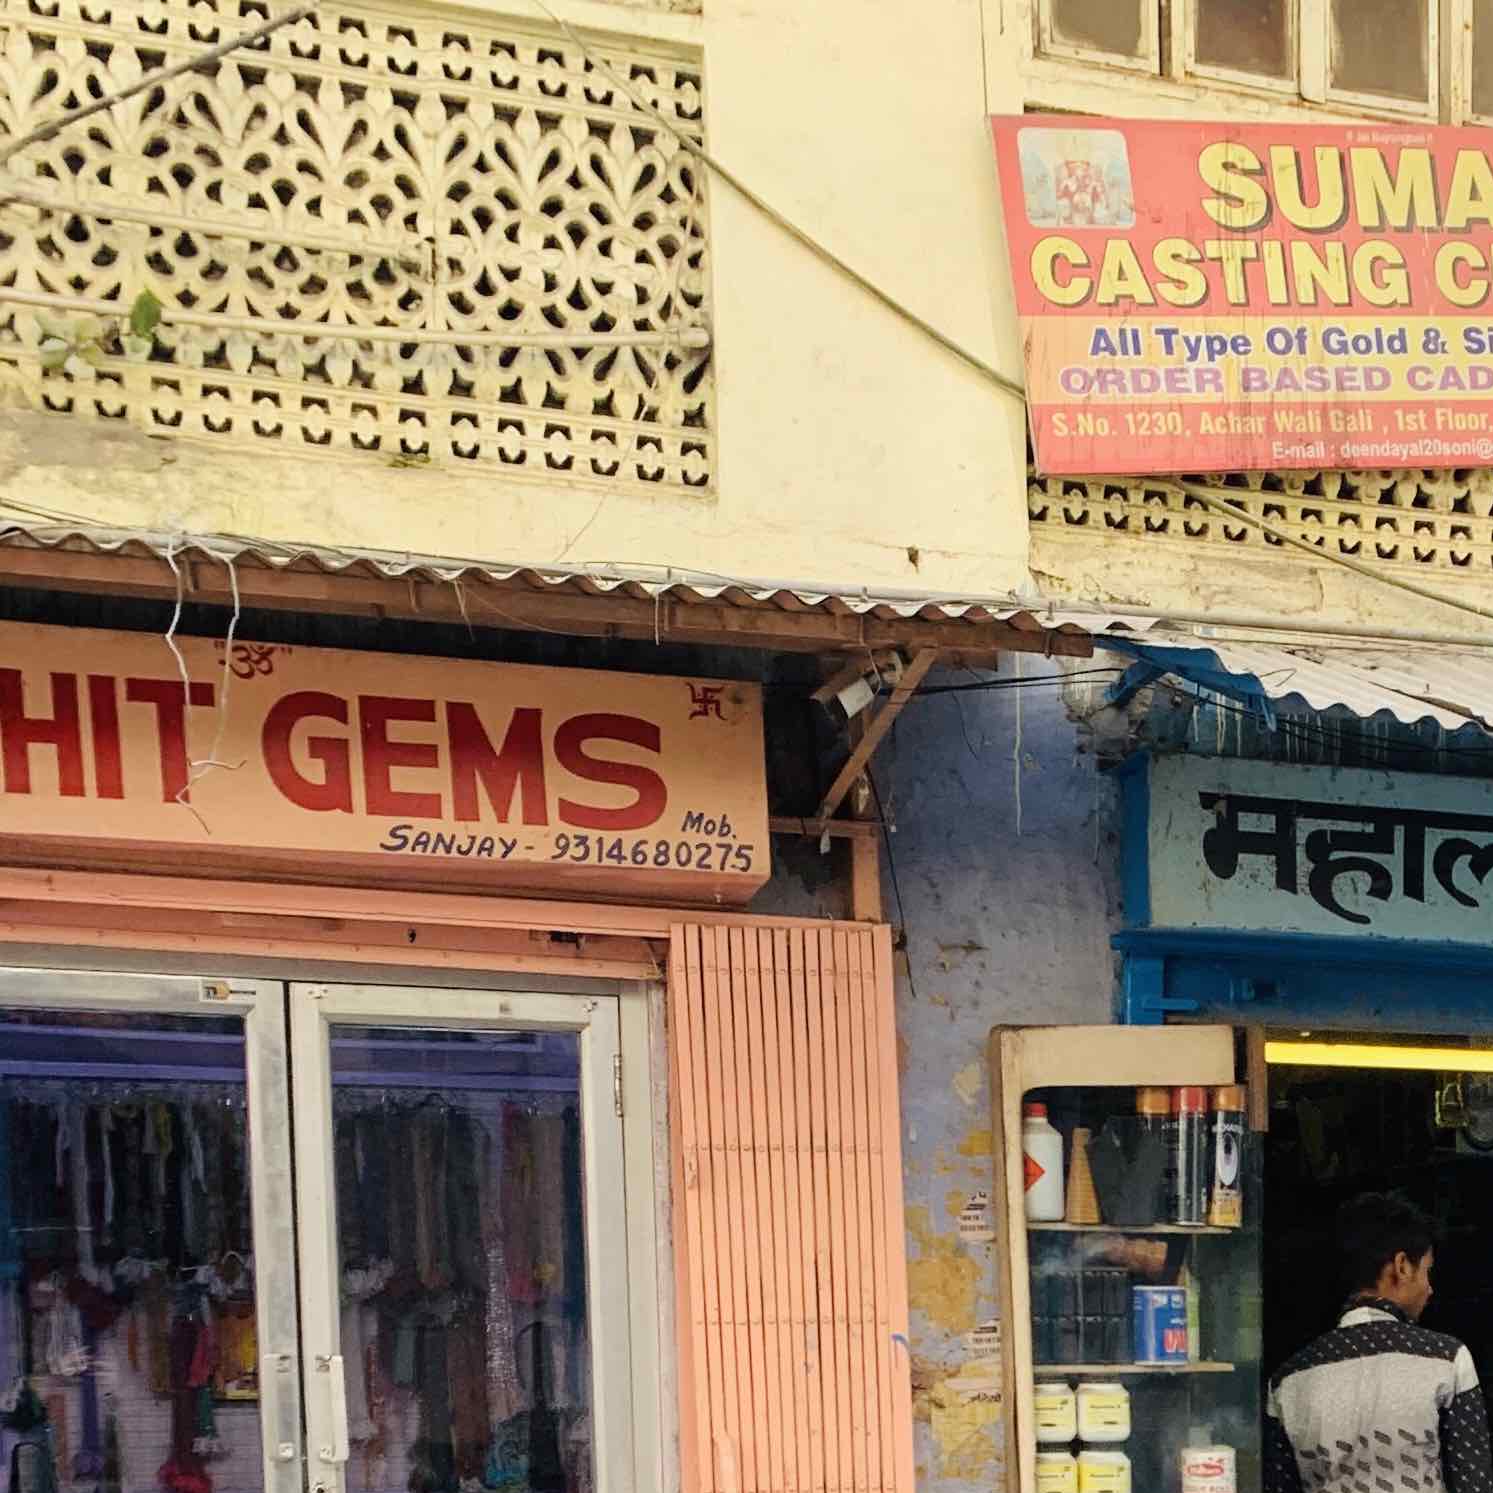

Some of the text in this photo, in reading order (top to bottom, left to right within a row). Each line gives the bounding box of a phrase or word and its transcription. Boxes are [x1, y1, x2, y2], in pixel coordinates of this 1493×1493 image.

[1029, 235, 1411, 308] CASTING
[1090, 327, 1142, 356] All
[1154, 327, 1252, 362] Type
[1265, 326, 1308, 356] Of
[1321, 327, 1408, 355] Gold
[1422, 327, 1449, 355] &
[1060, 367, 1224, 394] ORDER
[1241, 365, 1392, 393] BASED
[1200, 411, 1266, 436] Achar
[1273, 408, 1323, 433] Wali
[1393, 407, 1428, 433] 1st
[1271, 440, 1325, 460] E-mail
[0, 667, 669, 831] HIT GEMS
[681, 810, 737, 840] Mob.
[550, 833, 755, 873] 9314680275
